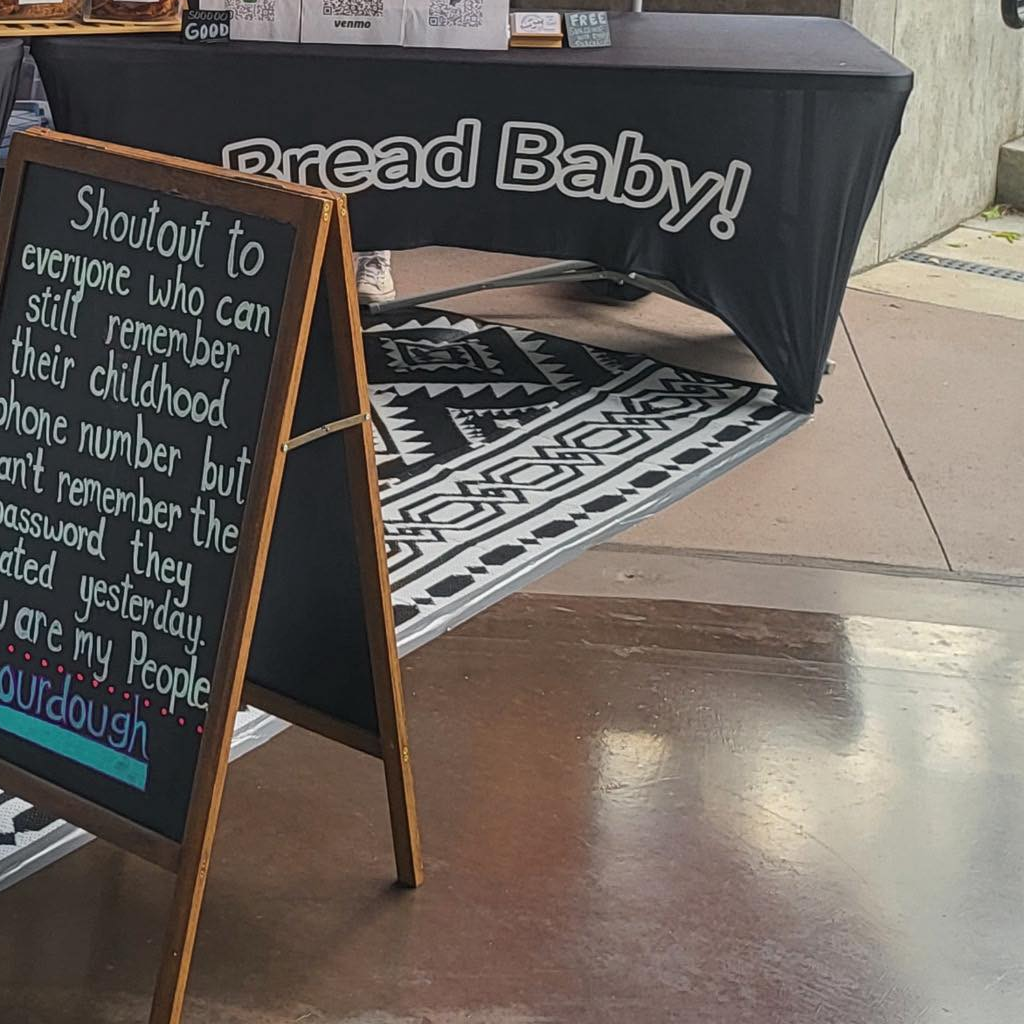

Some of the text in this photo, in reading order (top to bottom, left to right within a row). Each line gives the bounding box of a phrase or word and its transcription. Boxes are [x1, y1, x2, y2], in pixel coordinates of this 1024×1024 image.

[184, 22, 229, 41] GOOD
[334, 19, 372, 30] venmo
[569, 13, 607, 27] FREE
[222, 120, 751, 241] Bread Baby!
[70, 184, 265, 279] Shoutout to
[21, 243, 271, 338] everyone who can
[25, 286, 241, 373] still remember
[11, 324, 230, 429] their childhood
[78, 413, 182, 477] number
[200, 435, 252, 505] but
[57, 476, 183, 532] remember
[190, 495, 240, 554] the
[130, 529, 193, 608] they
[74, 573, 206, 656] yesterday.
[14, 605, 63, 653] are
[73, 627, 113, 683] my
[127, 629, 212, 715] People
